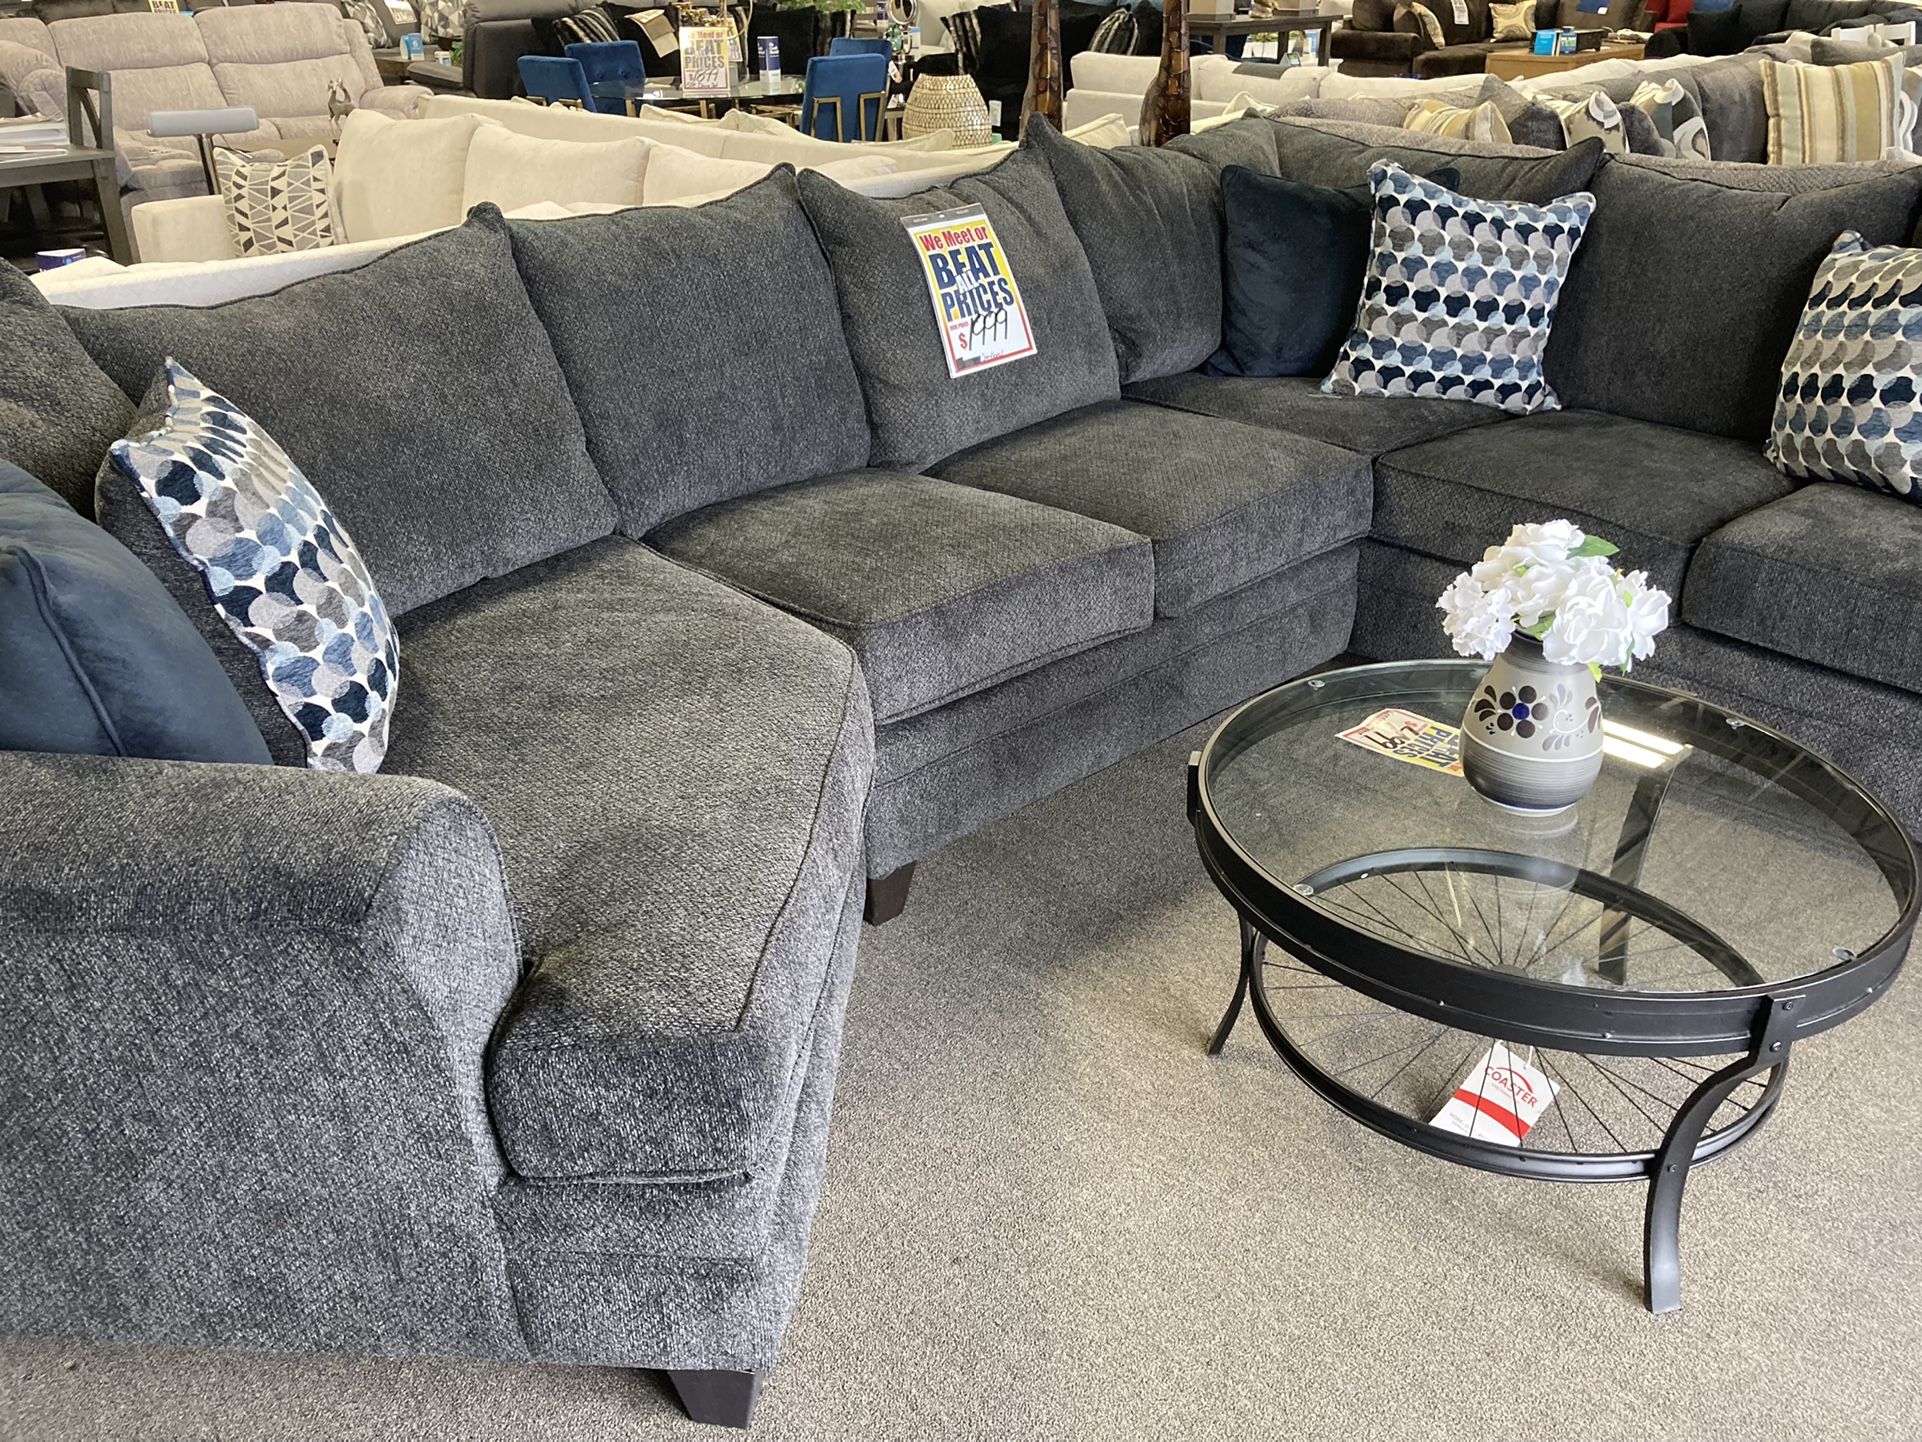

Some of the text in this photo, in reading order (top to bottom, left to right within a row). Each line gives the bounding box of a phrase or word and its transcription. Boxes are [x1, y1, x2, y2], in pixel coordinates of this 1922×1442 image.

[685, 56, 725, 69] PRICES
[920, 226, 989, 252] We Meet or
[928, 242, 1001, 290] BEAT
[954, 270, 980, 293] ALL
[941, 278, 1015, 322] PRICES
[1484, 1066, 1538, 1108] COASTER
